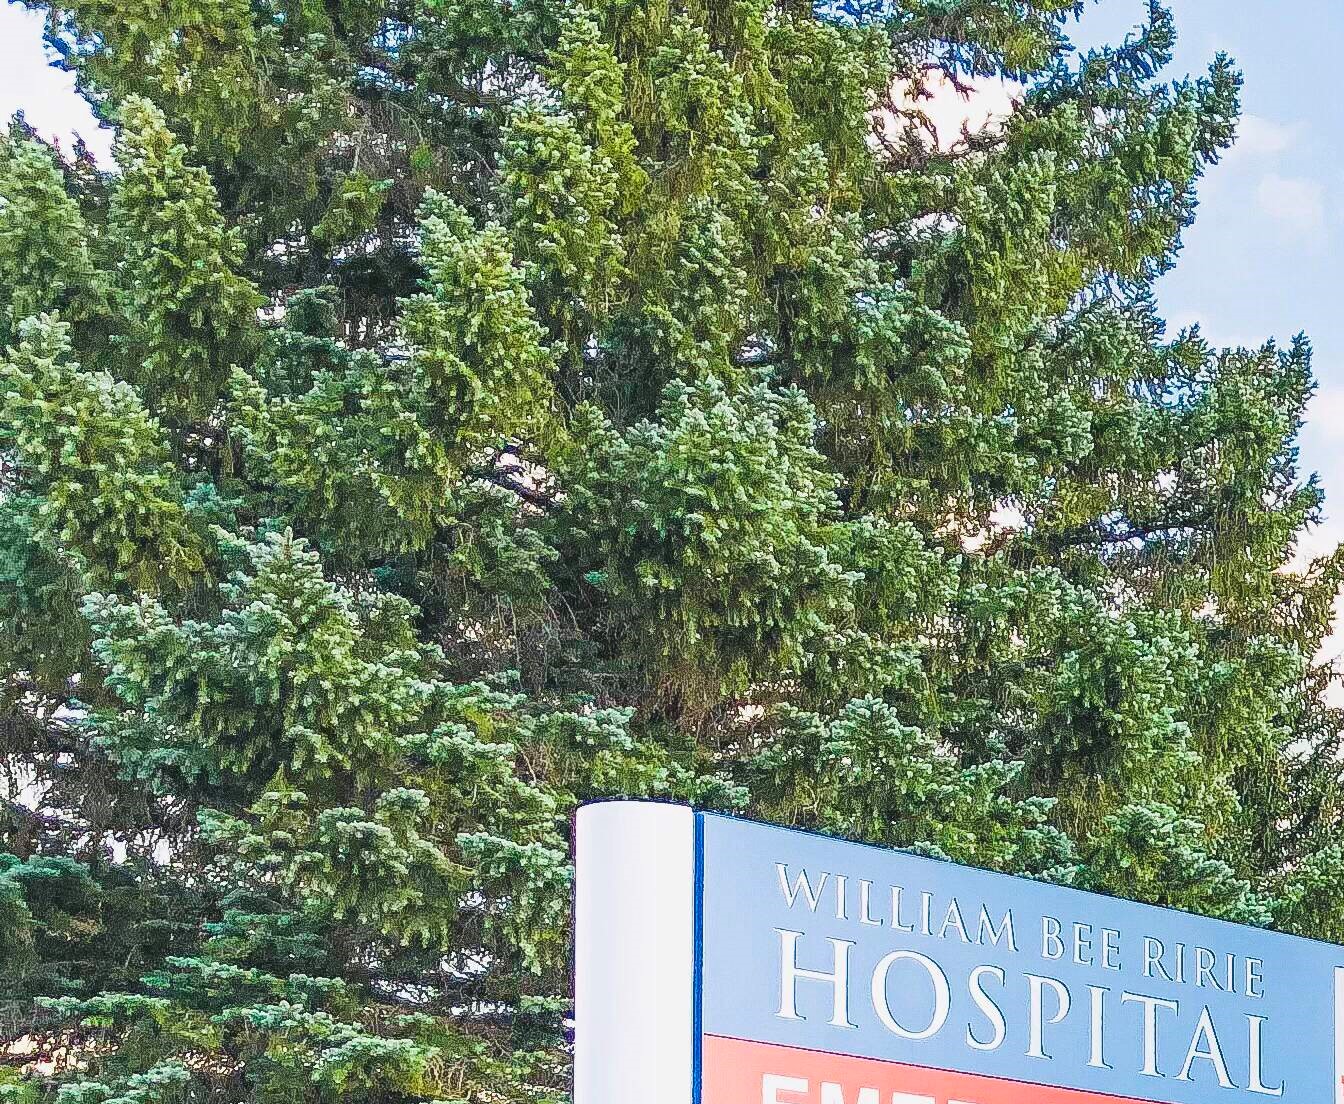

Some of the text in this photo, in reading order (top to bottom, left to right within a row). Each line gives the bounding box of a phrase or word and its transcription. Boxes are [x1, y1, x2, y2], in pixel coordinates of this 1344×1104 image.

[774, 862, 1267, 999] WILLIAM BEE RIRIE
[773, 926, 1286, 1097] HOSPITAL
